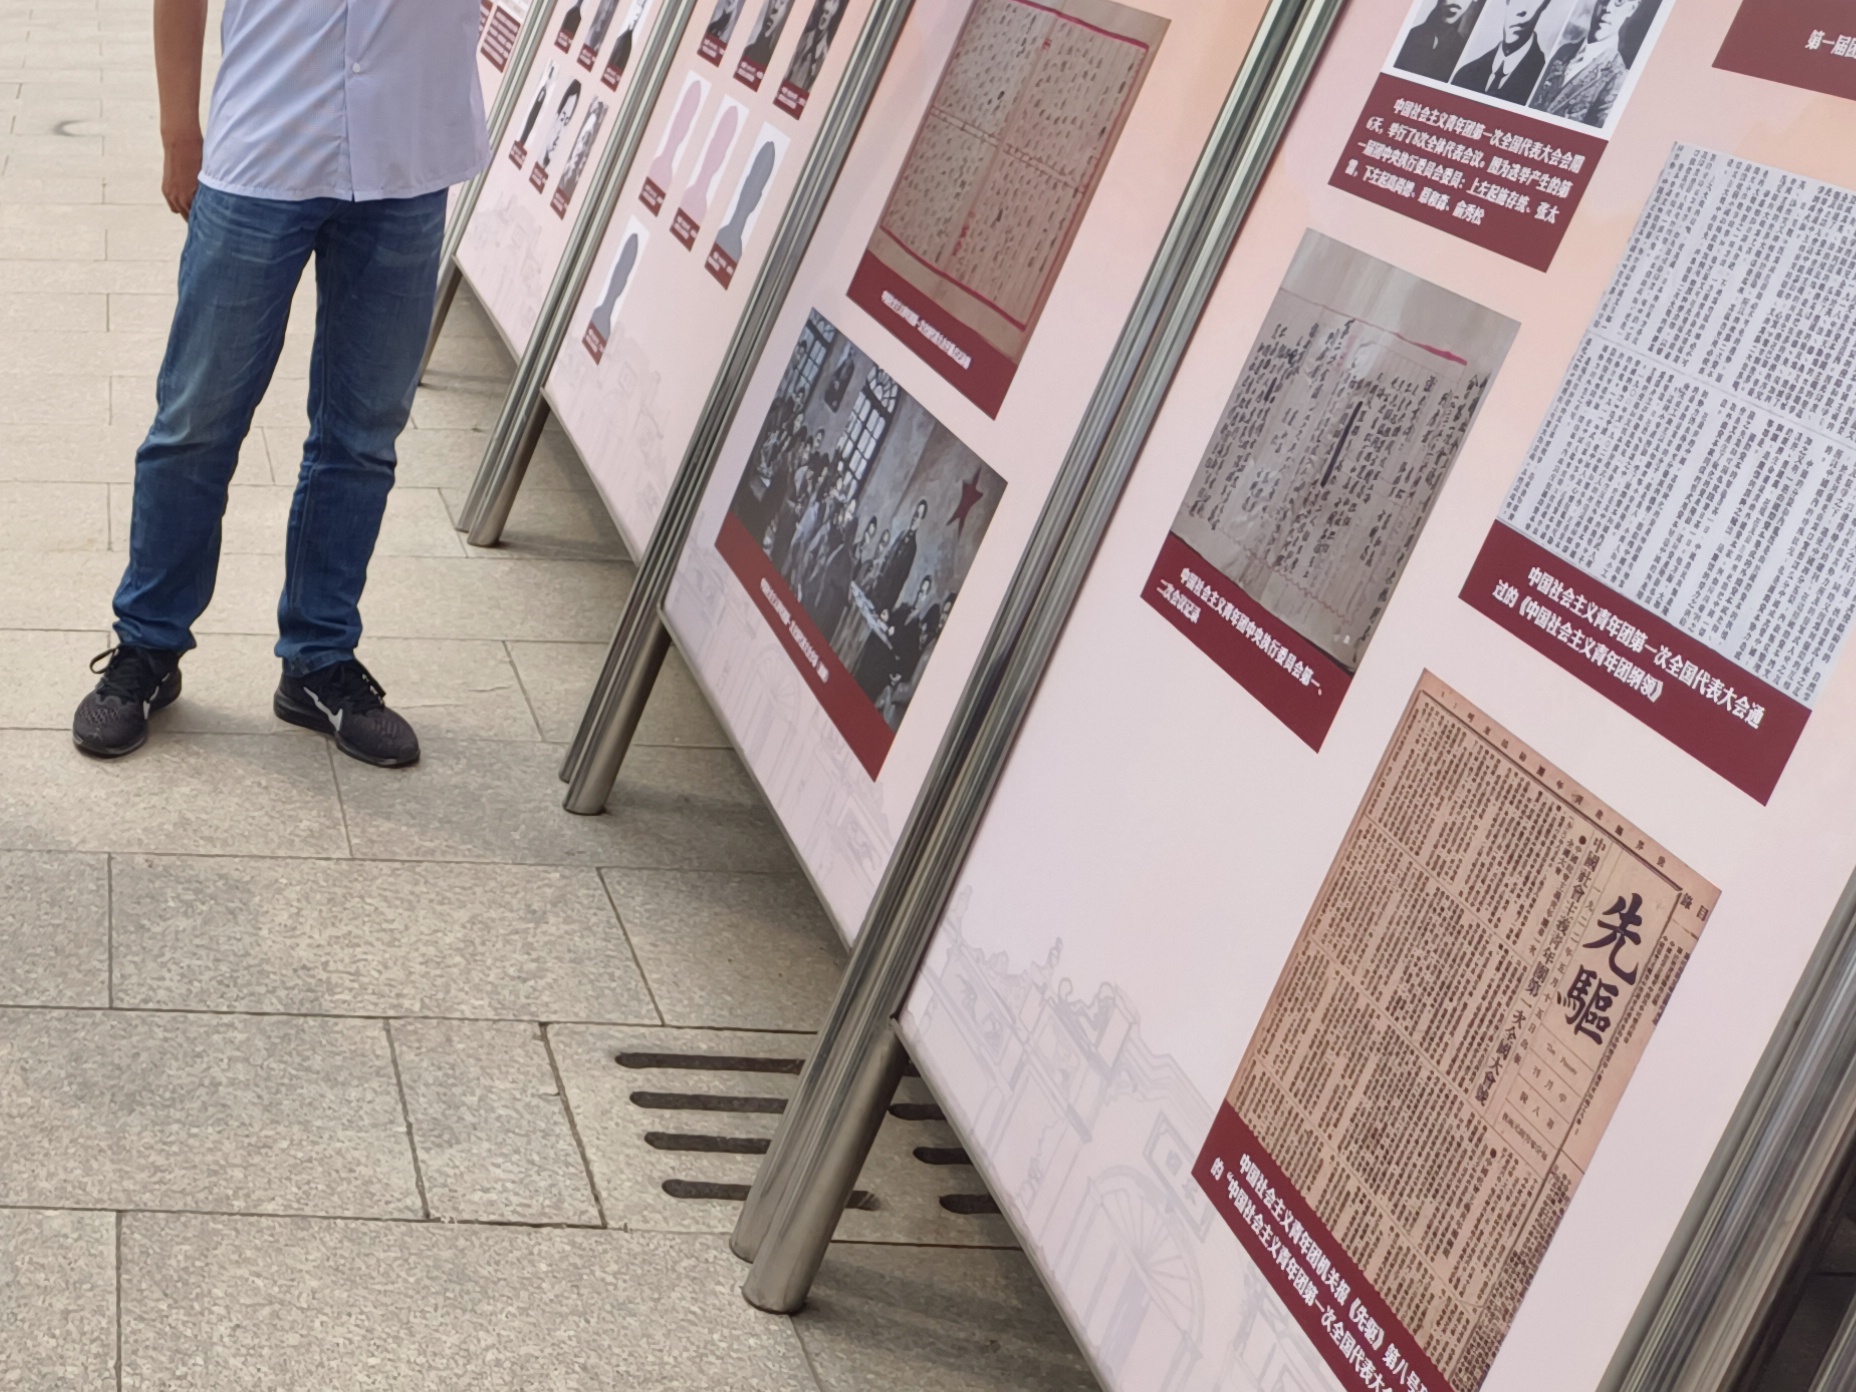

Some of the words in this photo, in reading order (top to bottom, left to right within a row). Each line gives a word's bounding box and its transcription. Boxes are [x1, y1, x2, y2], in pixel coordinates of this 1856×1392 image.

[1527, 566, 1765, 729] 中国社会主义青年团第一次全国代表大会通
